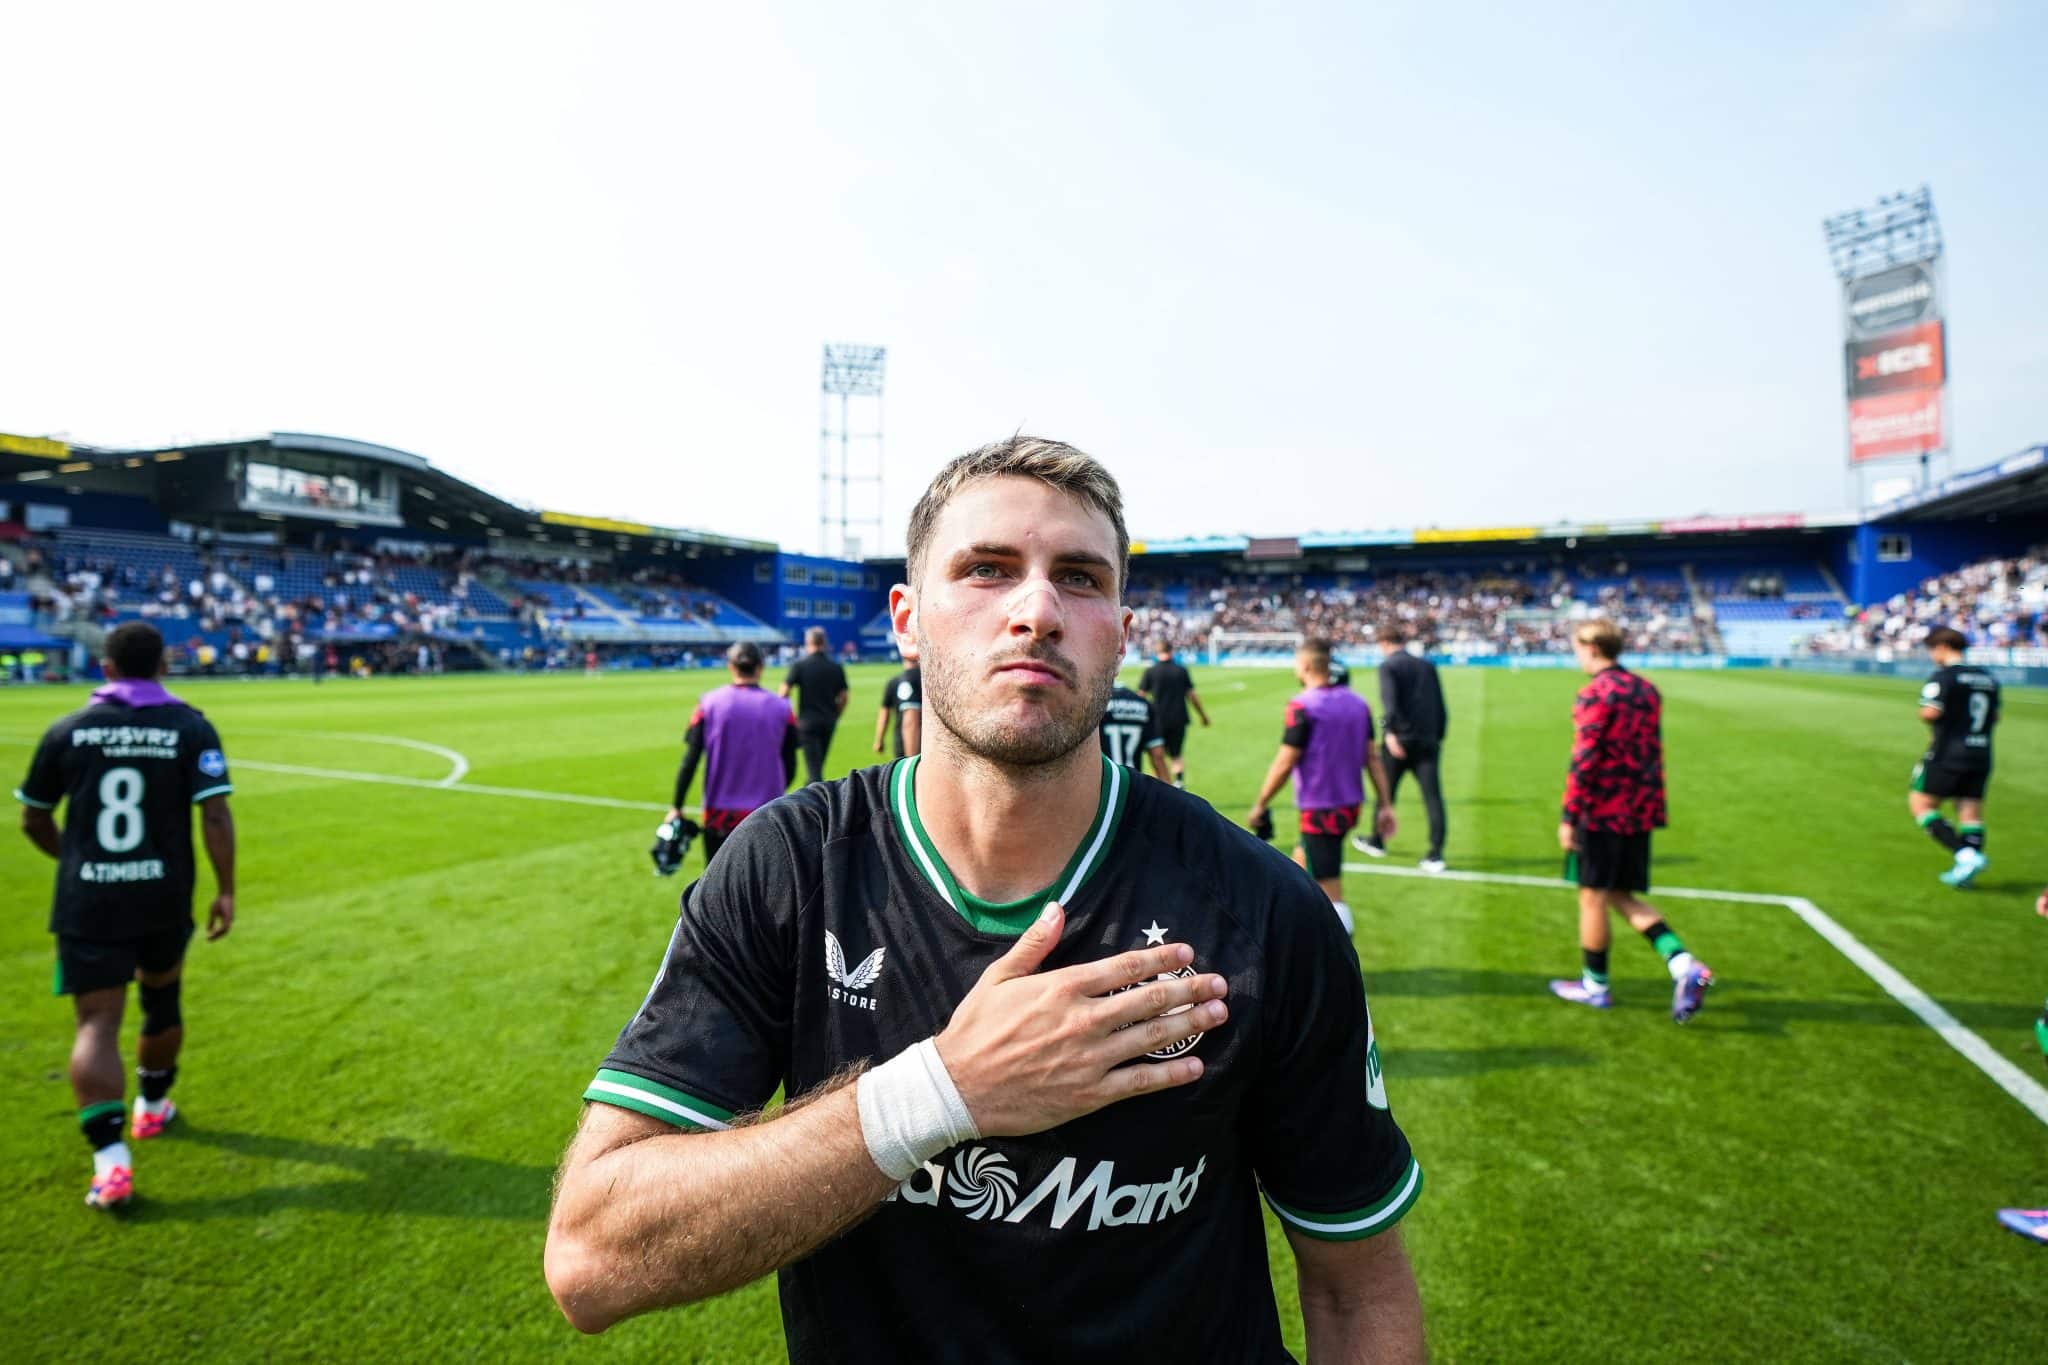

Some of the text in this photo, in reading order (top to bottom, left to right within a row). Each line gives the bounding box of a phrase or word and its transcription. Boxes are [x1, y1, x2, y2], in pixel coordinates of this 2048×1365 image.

[1969, 691, 1990, 733] 9
[1104, 724, 1143, 768] 17
[96, 766, 146, 853] 8
[827, 984, 878, 1011] STORE
[1002, 1154, 1206, 1231] Markt
